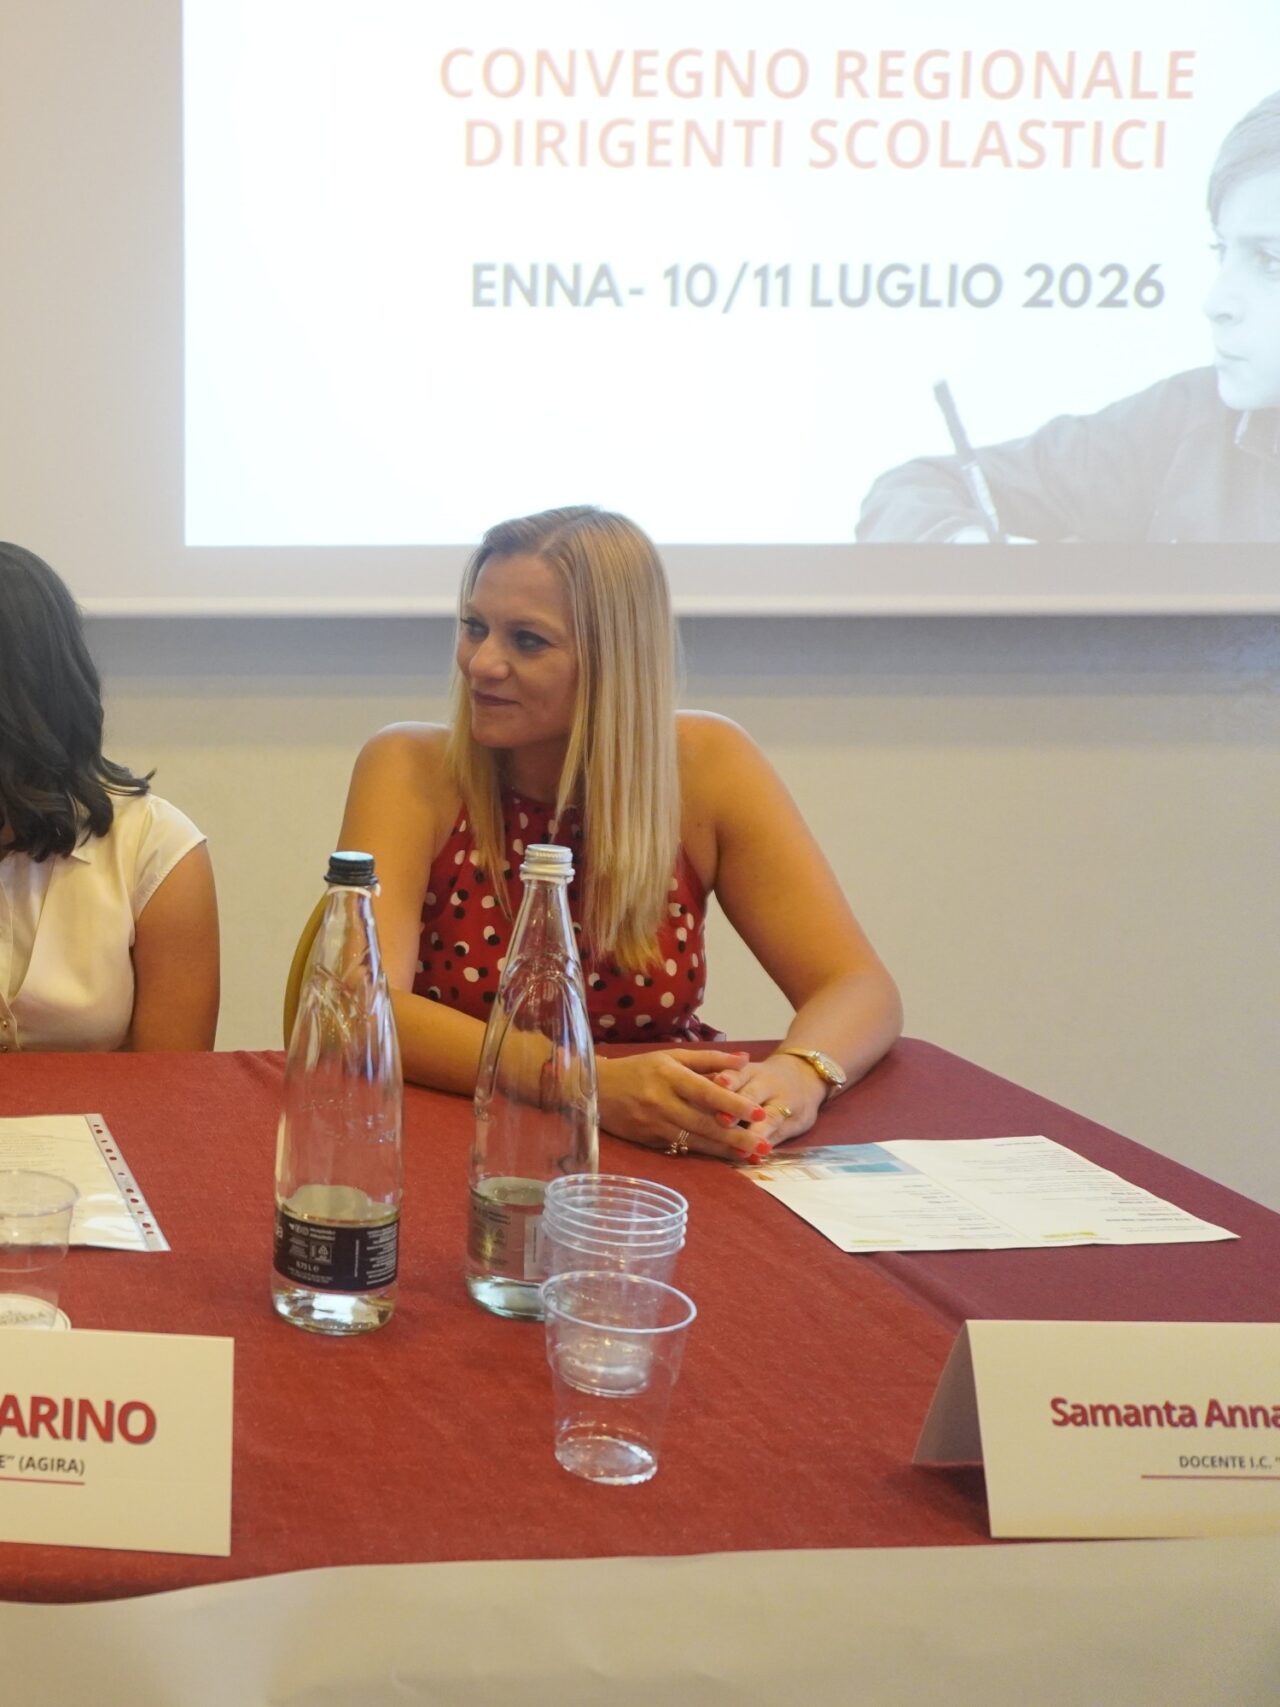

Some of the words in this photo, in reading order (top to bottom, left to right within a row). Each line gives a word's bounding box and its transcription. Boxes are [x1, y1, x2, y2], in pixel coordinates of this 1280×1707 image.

[439, 47, 810, 100] CONVEGNO
[835, 48, 1196, 101] REGIONALE
[464, 118, 784, 169] DIRIGENTI
[808, 118, 1167, 170] SCOLASTICI
[472, 262, 644, 308] ENNA-
[663, 261, 791, 314] 10/11
[810, 262, 1004, 309] LUGLIO
[1022, 262, 1166, 309] 2026
[1050, 1397, 1199, 1429] Samanta
[18, 1455, 86, 1477] (AGIRA)
[1178, 1455, 1246, 1470] DOCENTE
[1250, 1455, 1273, 1471] I.C.
